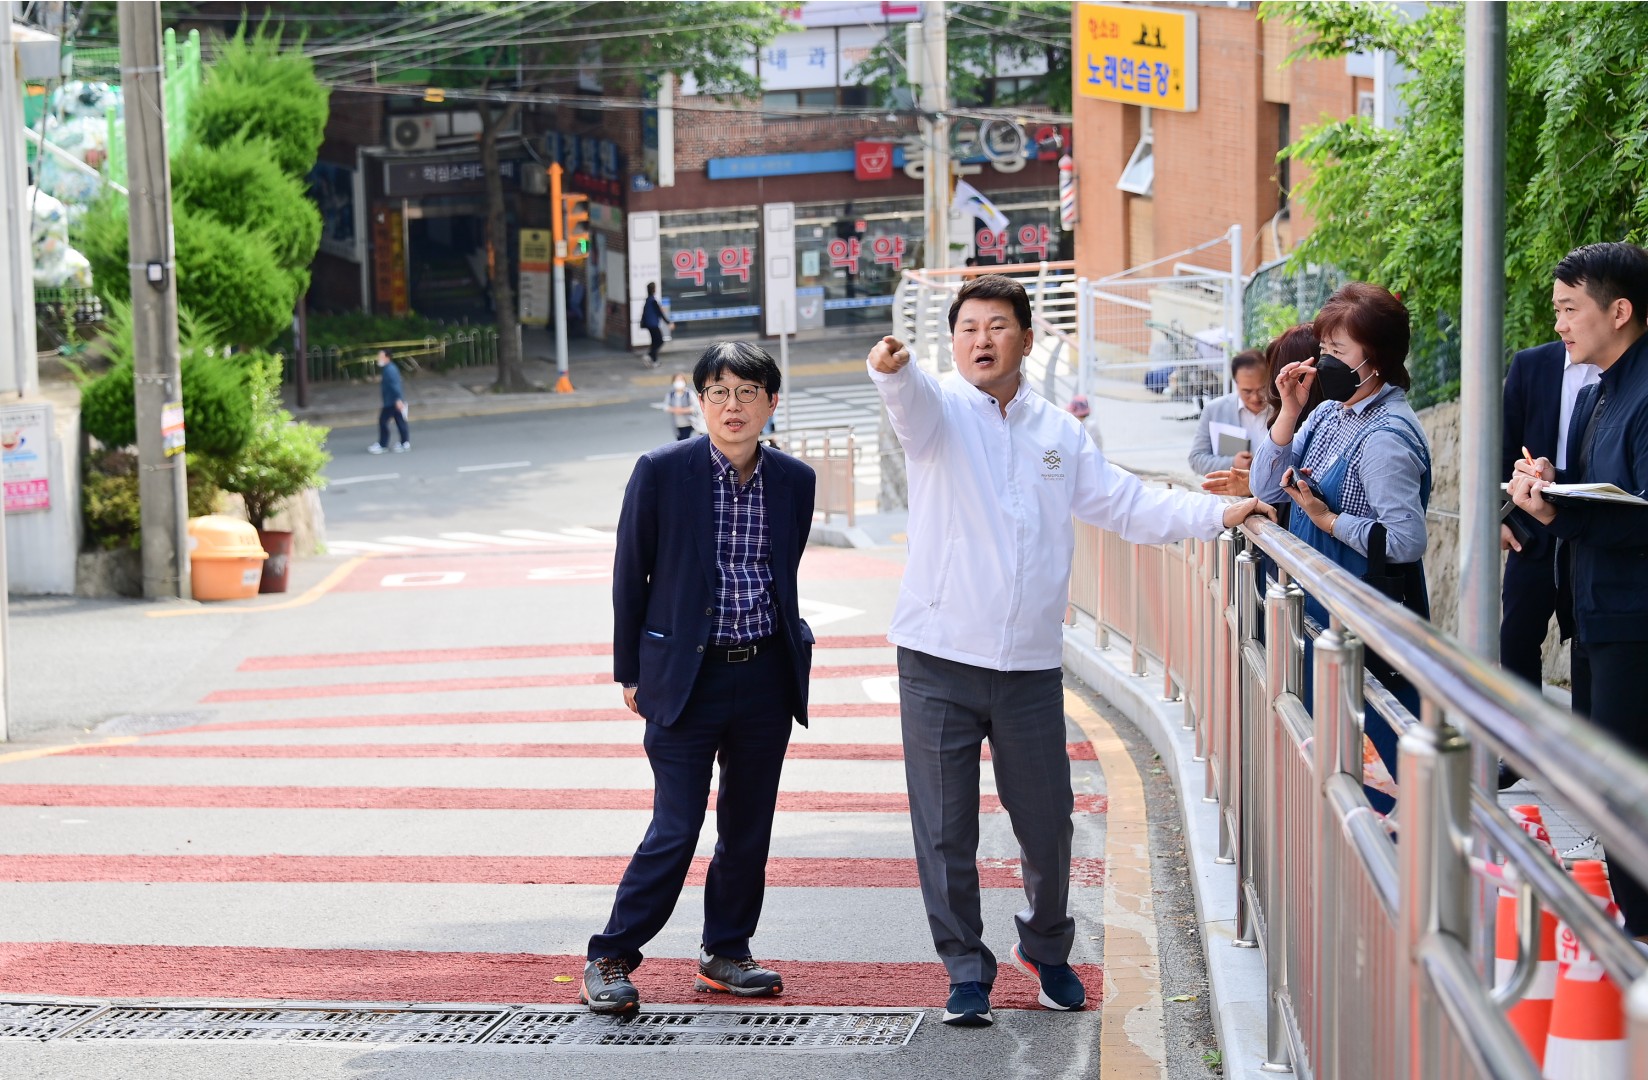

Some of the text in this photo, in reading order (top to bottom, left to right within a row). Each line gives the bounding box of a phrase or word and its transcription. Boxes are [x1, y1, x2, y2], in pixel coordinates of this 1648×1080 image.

[1087, 53, 1170, 98] 노래연습장
[827, 234, 906, 275] 약 약
[976, 222, 1051, 263] 약 약
[672, 245, 753, 287] 약 약
